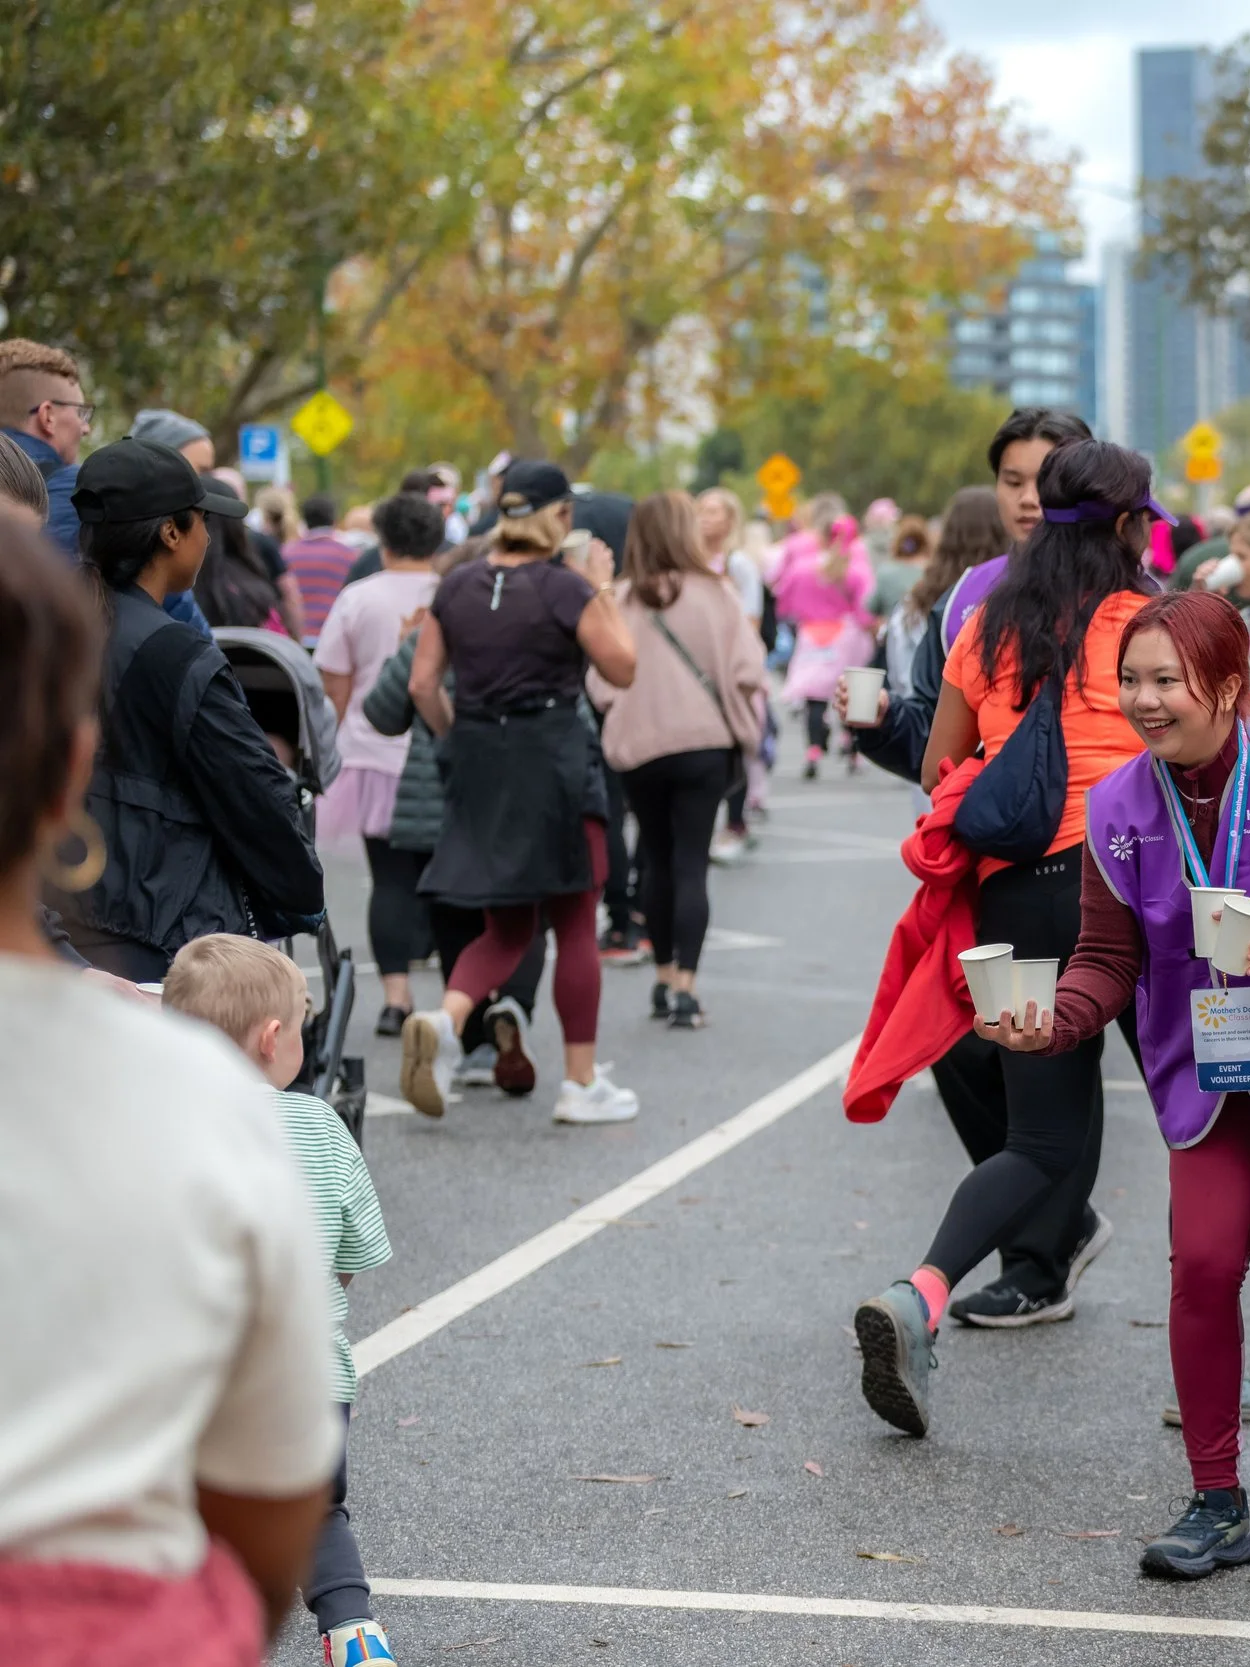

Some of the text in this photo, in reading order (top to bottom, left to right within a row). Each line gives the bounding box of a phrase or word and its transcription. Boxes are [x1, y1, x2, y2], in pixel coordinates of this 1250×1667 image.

[249, 430, 271, 461] P
[1237, 773, 1247, 786] Day
[1144, 835, 1164, 843] Classic
[1210, 1007, 1241, 1015] Mother's
[1219, 1065, 1242, 1073] EVENT
